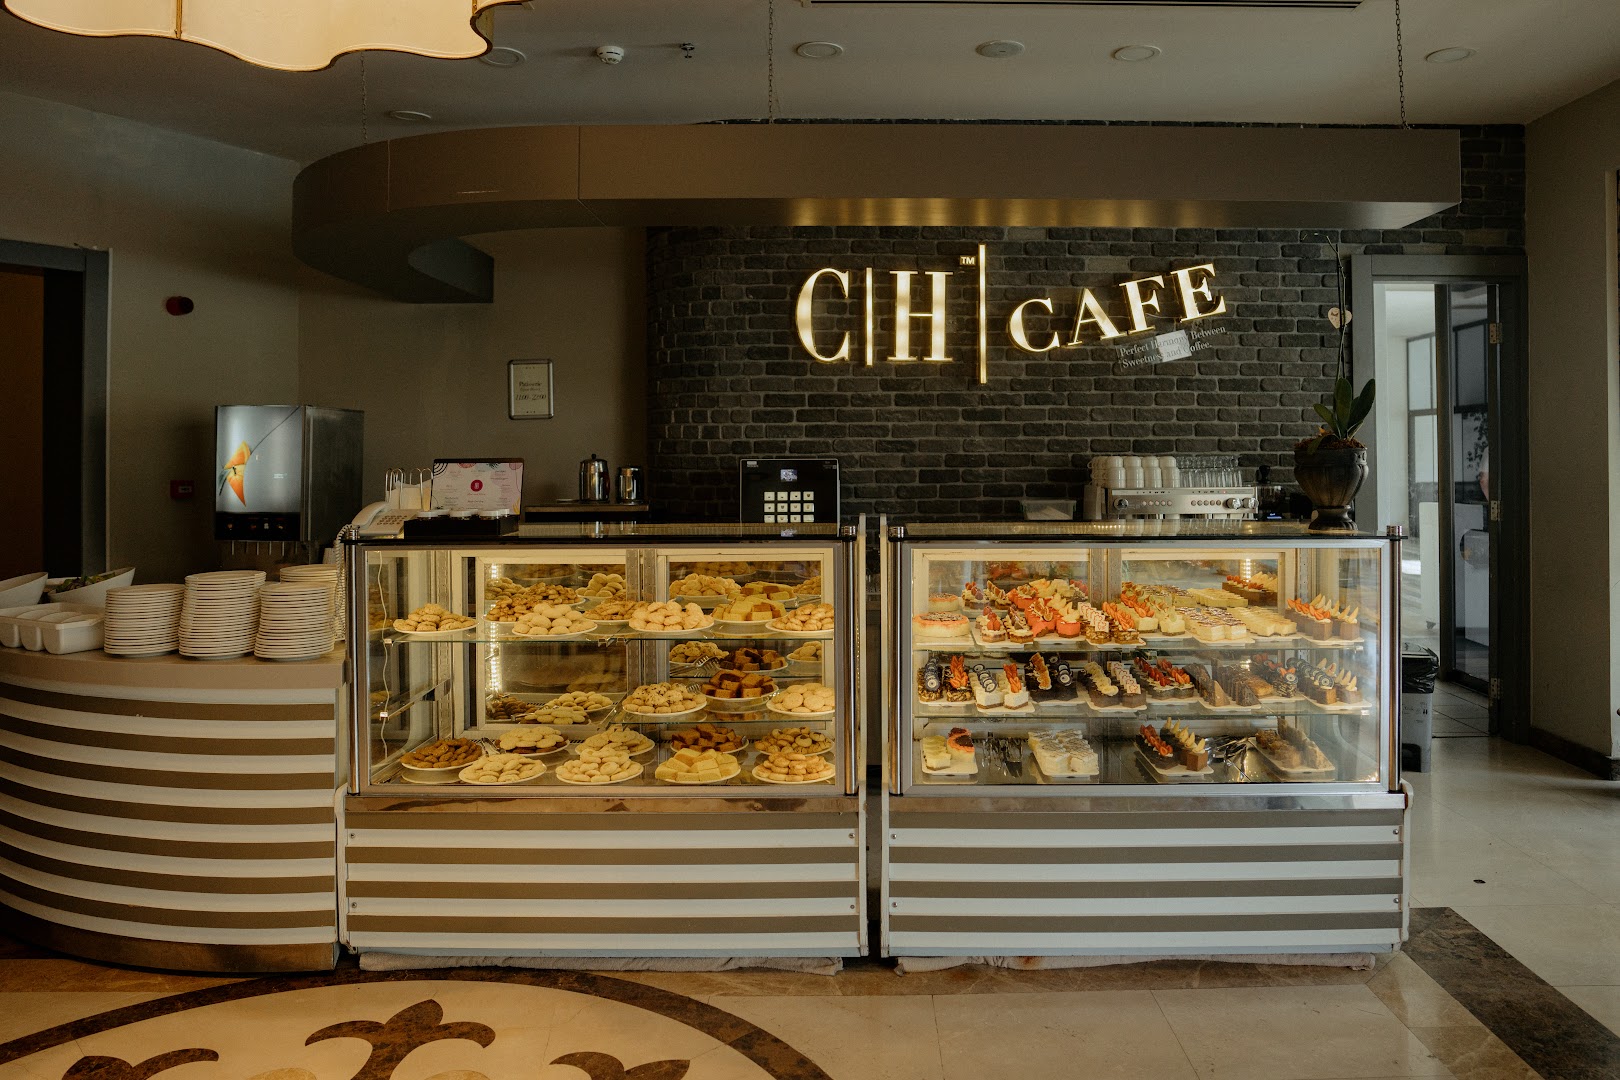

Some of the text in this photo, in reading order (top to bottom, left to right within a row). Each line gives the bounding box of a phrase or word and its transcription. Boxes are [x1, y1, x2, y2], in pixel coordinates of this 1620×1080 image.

[960, 256, 975, 265] TM
[1008, 262, 1227, 353] CAFE
[1119, 342, 1149, 357] Perfect
[1191, 326, 1226, 340] Between
[1122, 353, 1164, 368] Sweetness
[1166, 346, 1182, 358] and
